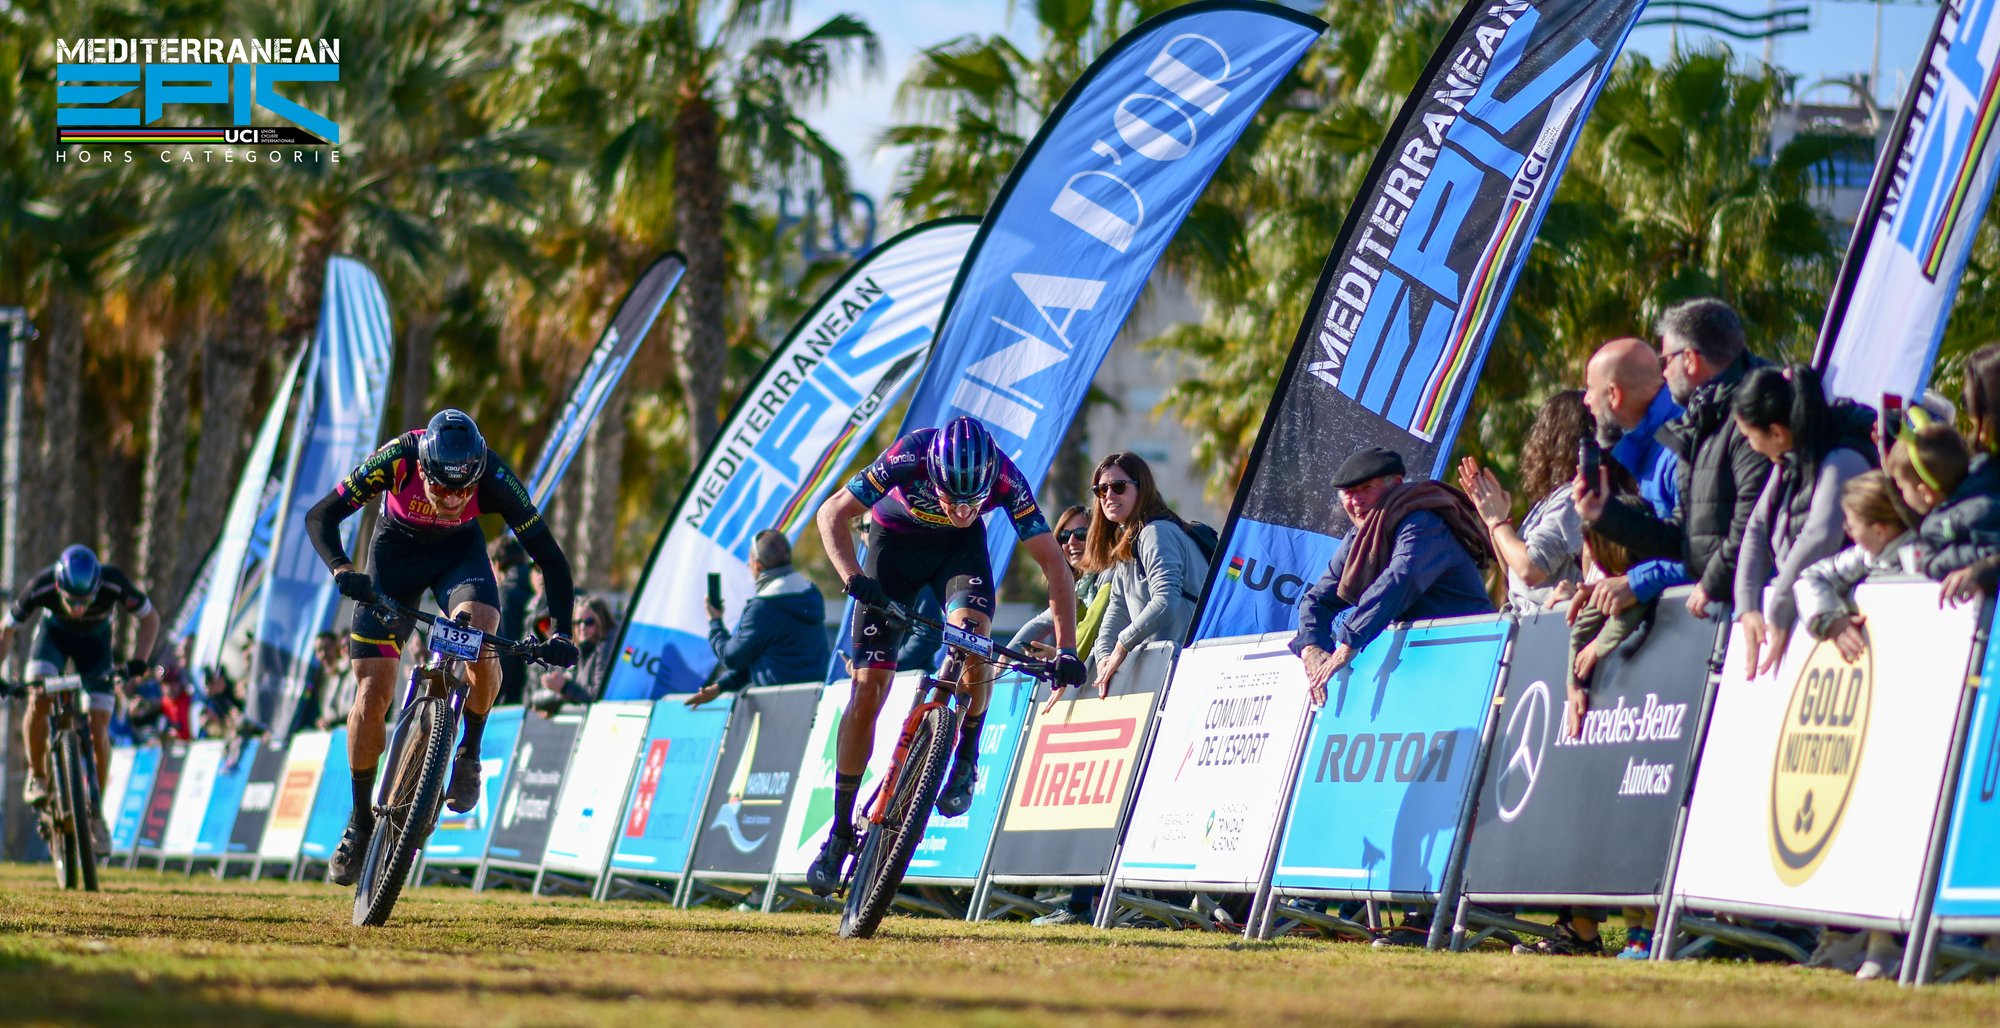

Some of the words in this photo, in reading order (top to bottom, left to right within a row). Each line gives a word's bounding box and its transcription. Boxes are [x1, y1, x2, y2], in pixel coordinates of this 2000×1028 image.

[1306, 0, 1530, 388] MEDITERRANEAN
[1512, 151, 1548, 201] UCI
[1337, 4, 1601, 431] EPIC
[950, 272, 1107, 440] INA
[686, 276, 884, 529] MEDITERRANEAN
[700, 293, 935, 562] EPIC
[851, 394, 880, 426] UCI
[968, 595, 988, 608] 7C
[1243, 557, 1315, 609] UC
[442, 627, 470, 644] 139
[865, 650, 886, 662] 7C
[961, 632, 978, 643] 10
[1205, 695, 1272, 729] COMUNITAT
[1554, 693, 1687, 746] Mrcedes-Benz
[1799, 667, 1863, 726] GOLD
[1019, 717, 1137, 807] PIRELLI
[1197, 736, 1218, 766] DE
[1214, 732, 1270, 766] L'ESPORT
[1781, 732, 1856, 775] NUTRITION
[1617, 755, 1674, 795] Autocas
